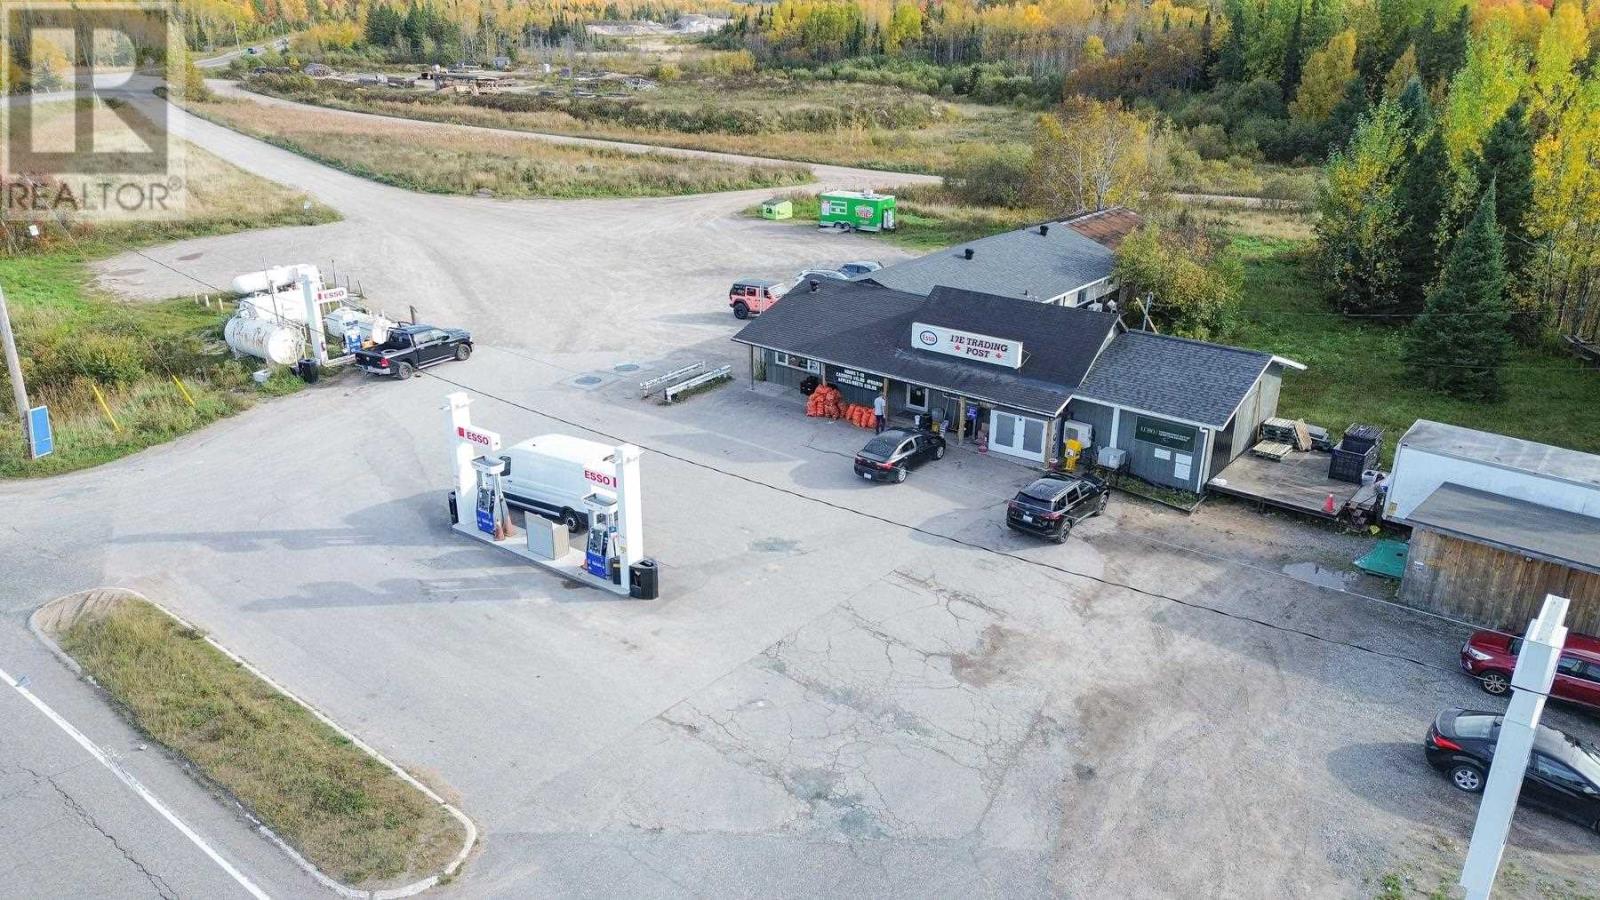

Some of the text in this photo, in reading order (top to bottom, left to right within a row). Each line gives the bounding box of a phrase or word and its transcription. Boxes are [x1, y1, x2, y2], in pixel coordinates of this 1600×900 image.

[324, 290, 344, 299] ESSO
[951, 335, 1009, 352] 17E TRADING
[966, 347, 990, 359] POST
[466, 432, 489, 446] ESSO
[584, 469, 611, 486] ESSO
